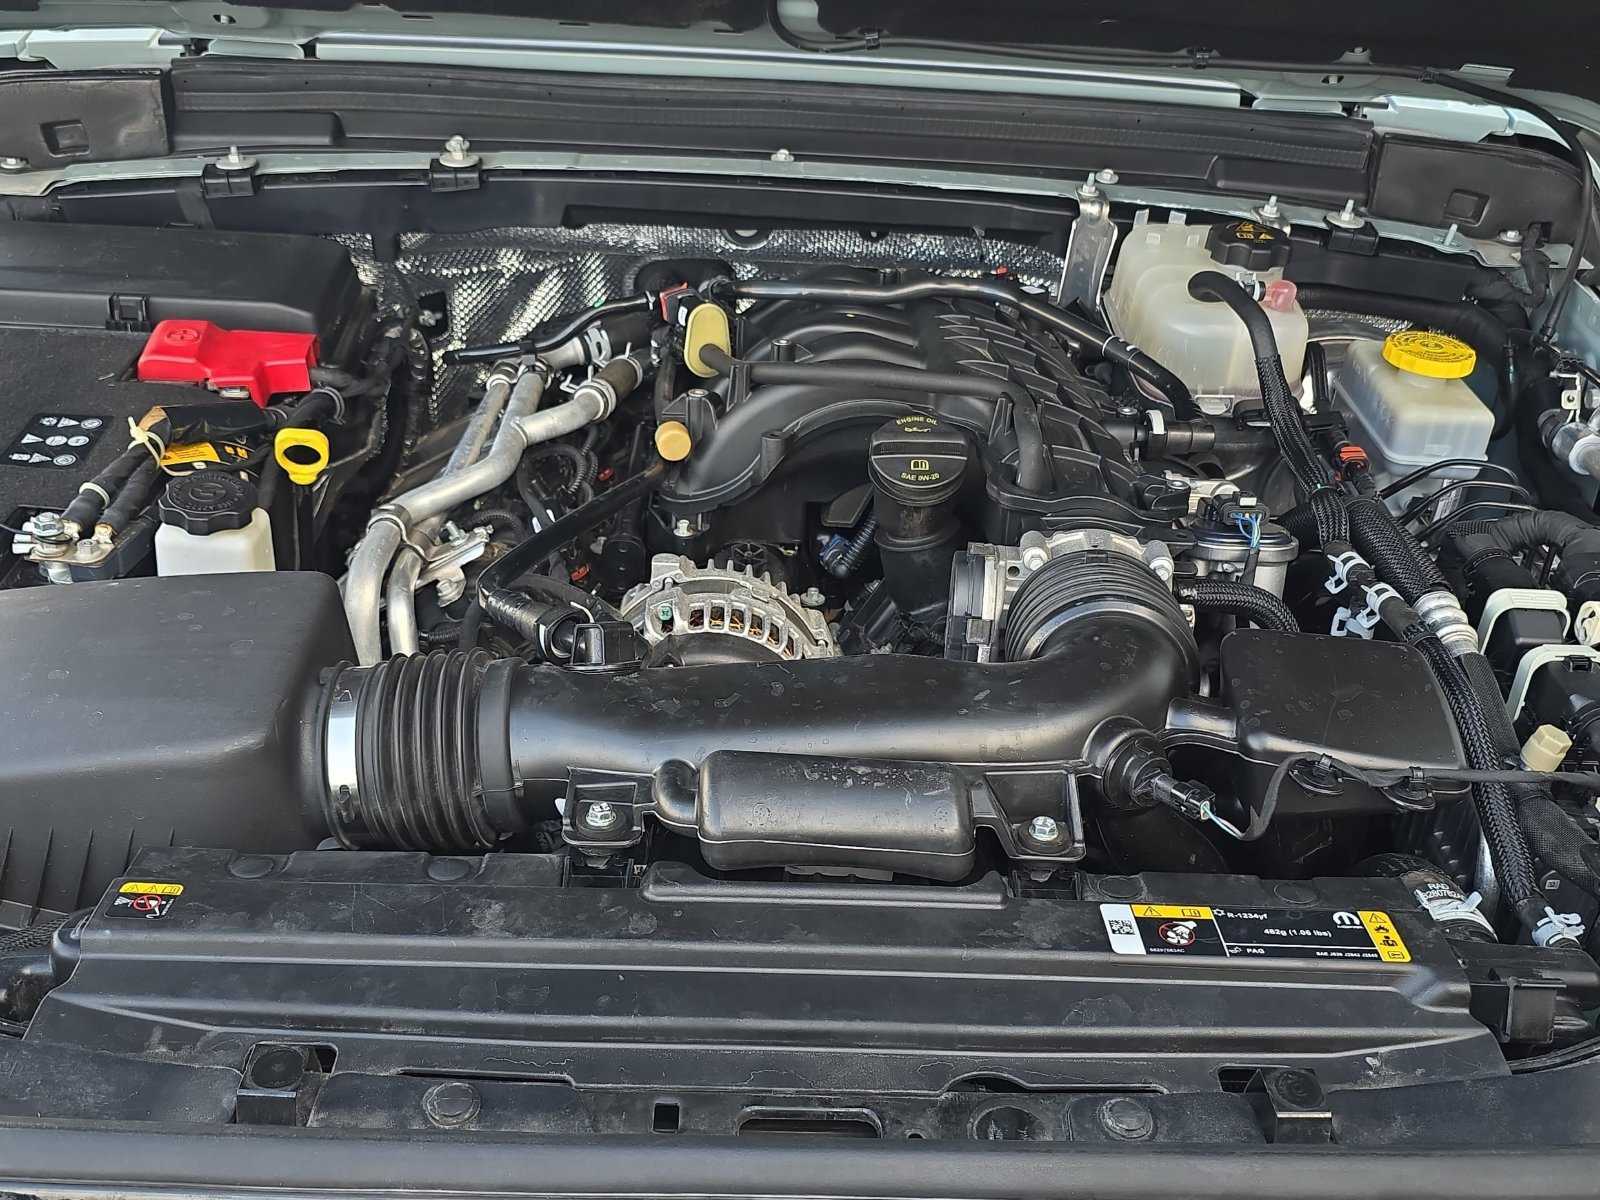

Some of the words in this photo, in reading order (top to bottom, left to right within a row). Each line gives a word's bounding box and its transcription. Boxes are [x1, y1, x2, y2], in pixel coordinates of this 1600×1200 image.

[896, 416, 925, 425] ENGINE
[926, 418, 938, 426] OIL
[901, 472, 917, 480] SAE
[917, 472, 940, 481] 0W-20
[1227, 912, 1268, 920] R-1234yf
[1264, 929, 1287, 937] 482g
[1312, 930, 1332, 938] lbs)
